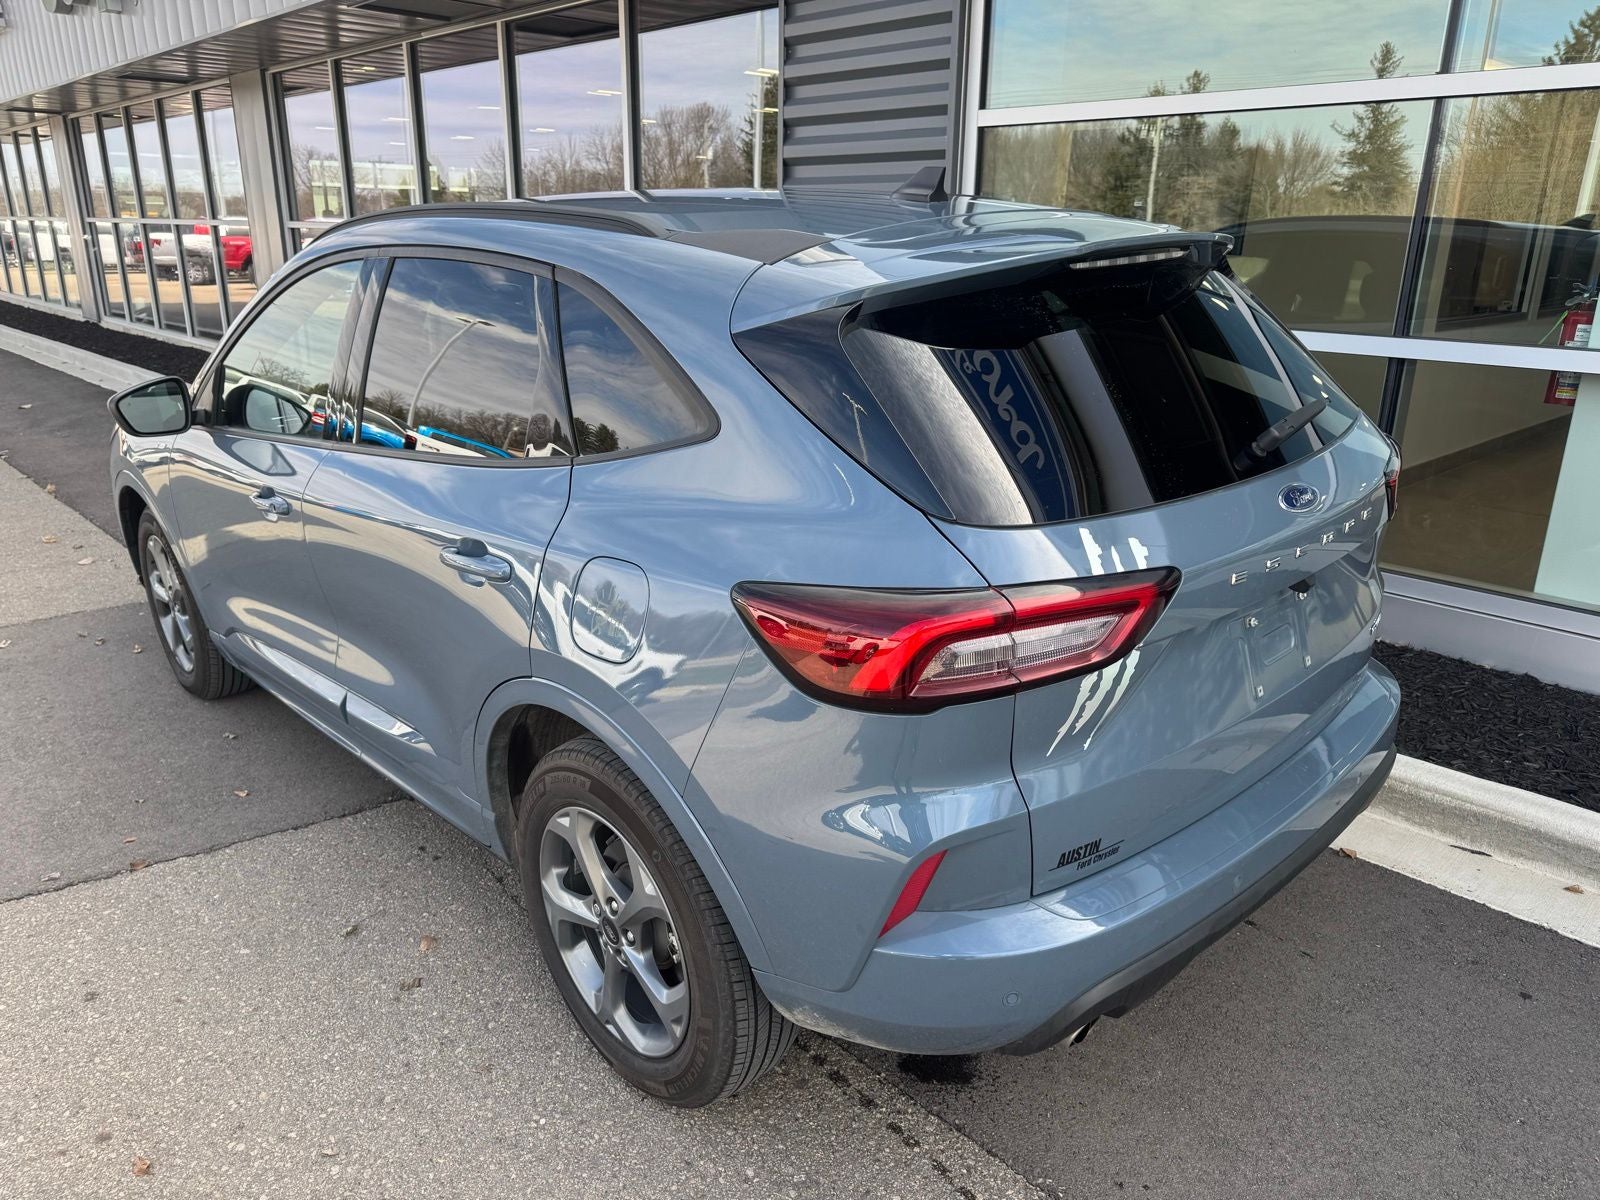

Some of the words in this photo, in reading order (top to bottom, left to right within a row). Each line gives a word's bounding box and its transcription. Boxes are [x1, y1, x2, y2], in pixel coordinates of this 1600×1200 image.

[1231, 507, 1373, 585] ESCAPE
[1056, 838, 1102, 869] AUSTIN
[1076, 857, 1092, 871] Ford
[1093, 846, 1121, 865] Chrysler
